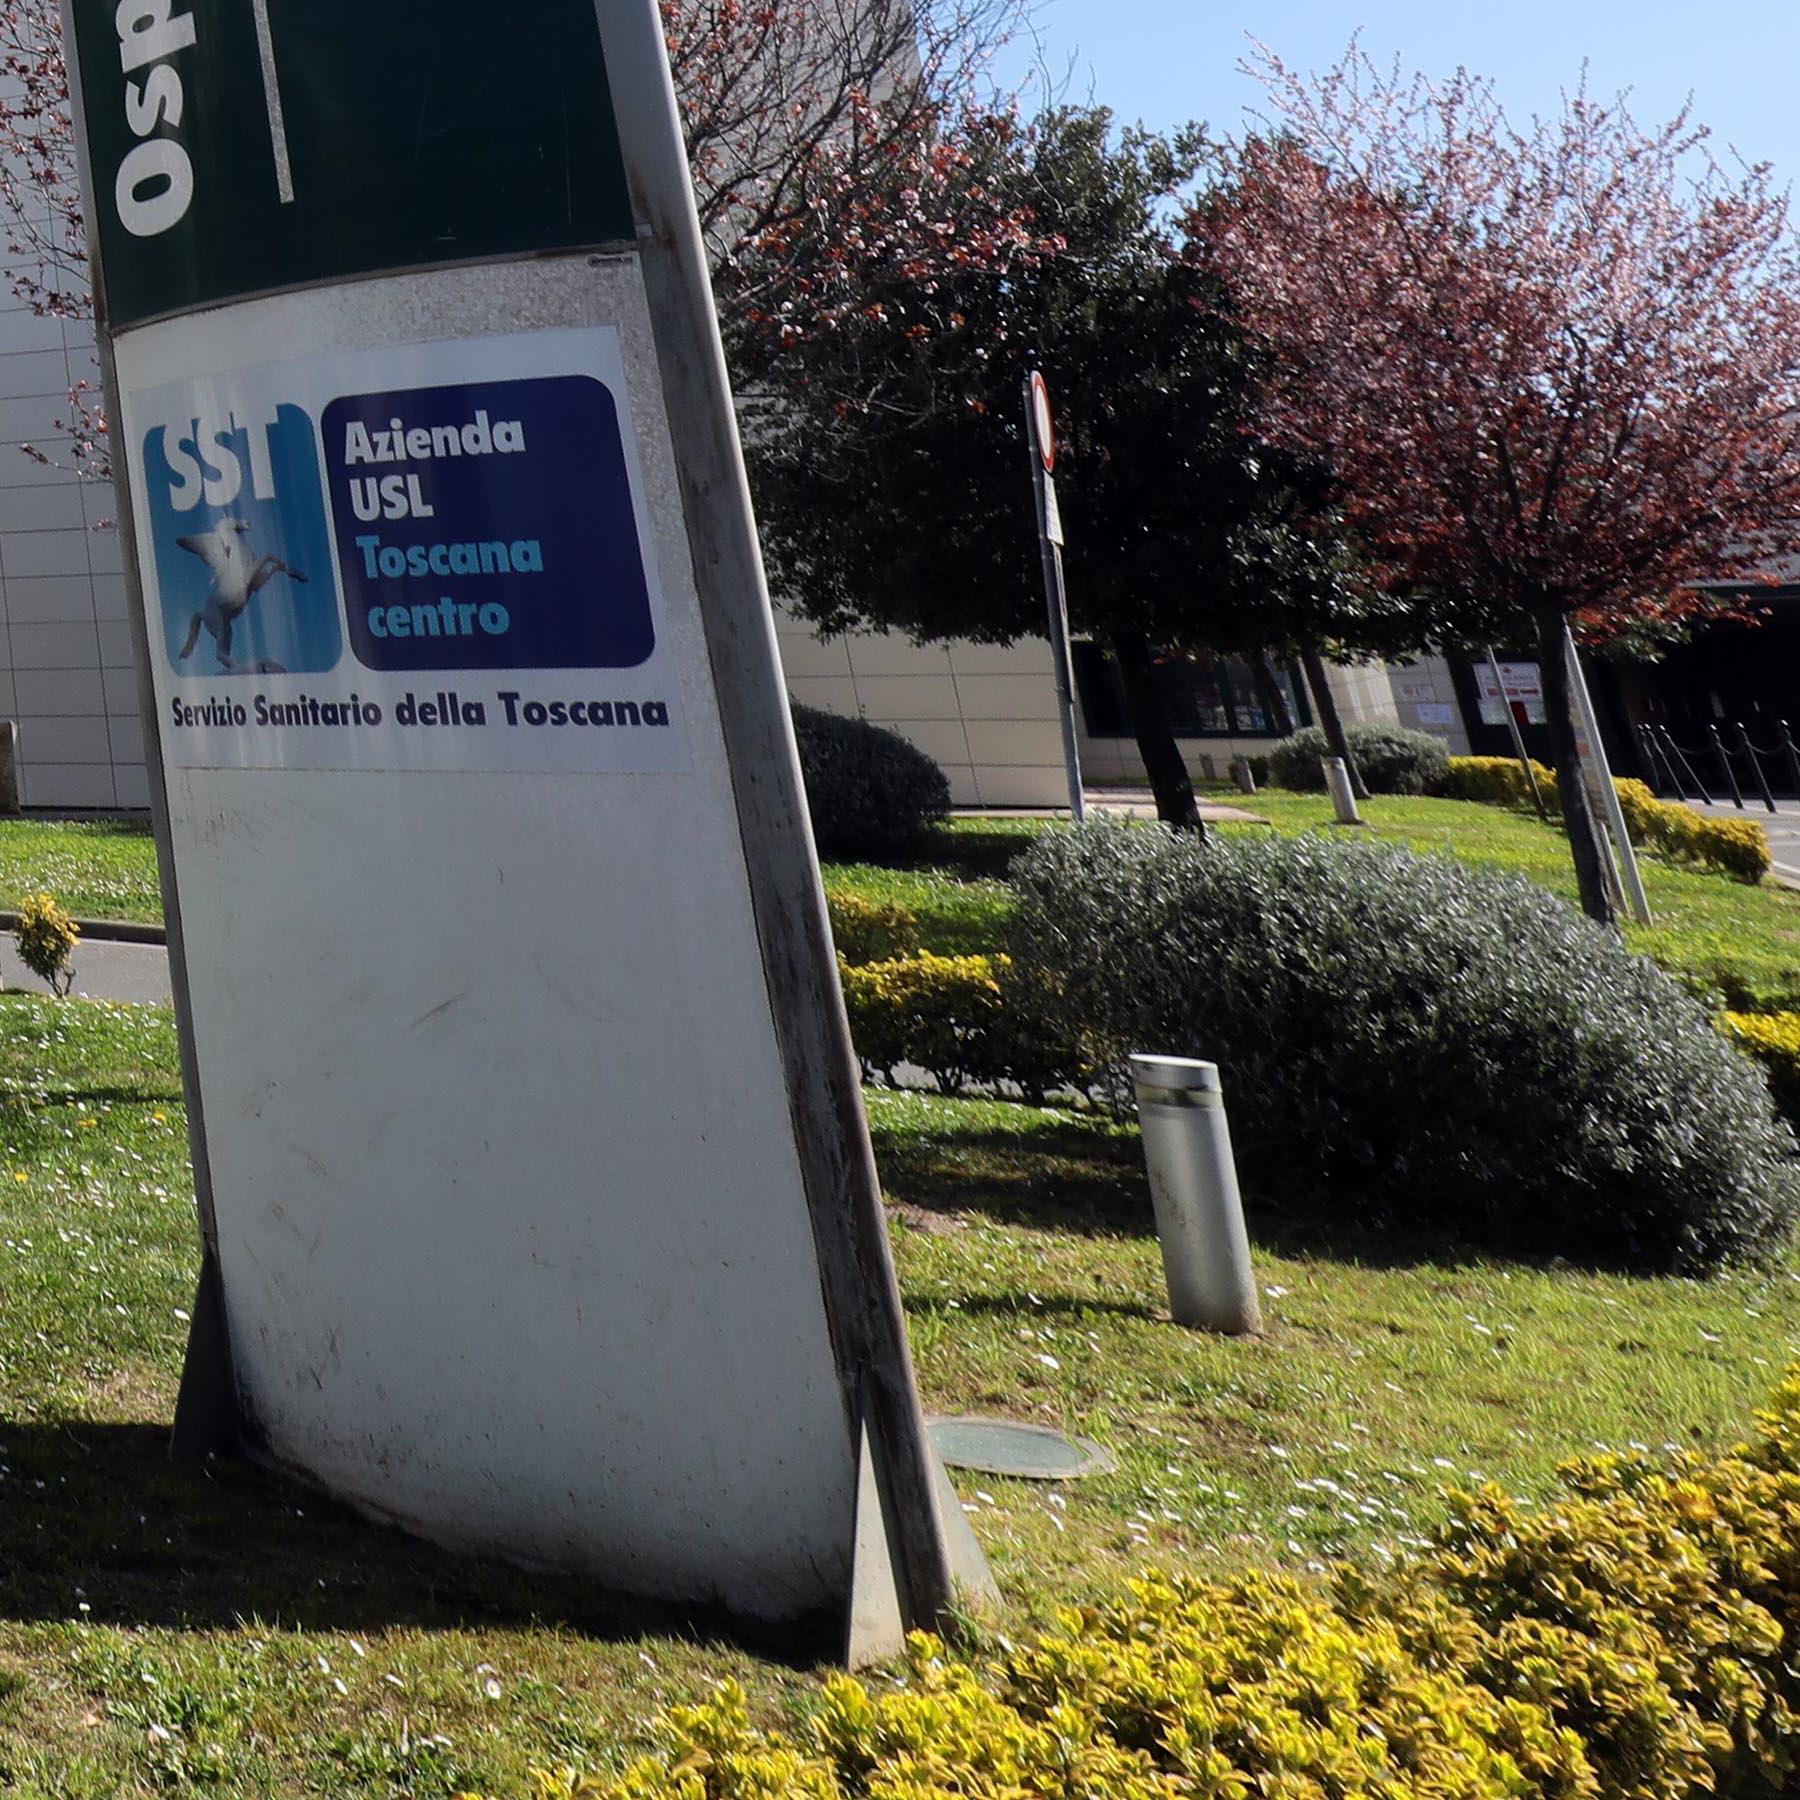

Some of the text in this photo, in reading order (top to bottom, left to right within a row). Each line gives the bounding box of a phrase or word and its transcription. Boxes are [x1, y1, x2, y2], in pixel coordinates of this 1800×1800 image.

[163, 403, 279, 512] SST
[344, 409, 526, 465] Azienda
[349, 473, 434, 521] USL
[355, 535, 544, 580] Toscana
[367, 597, 510, 638] centro
[171, 691, 669, 727] Servizio Sanitario della Toscana
